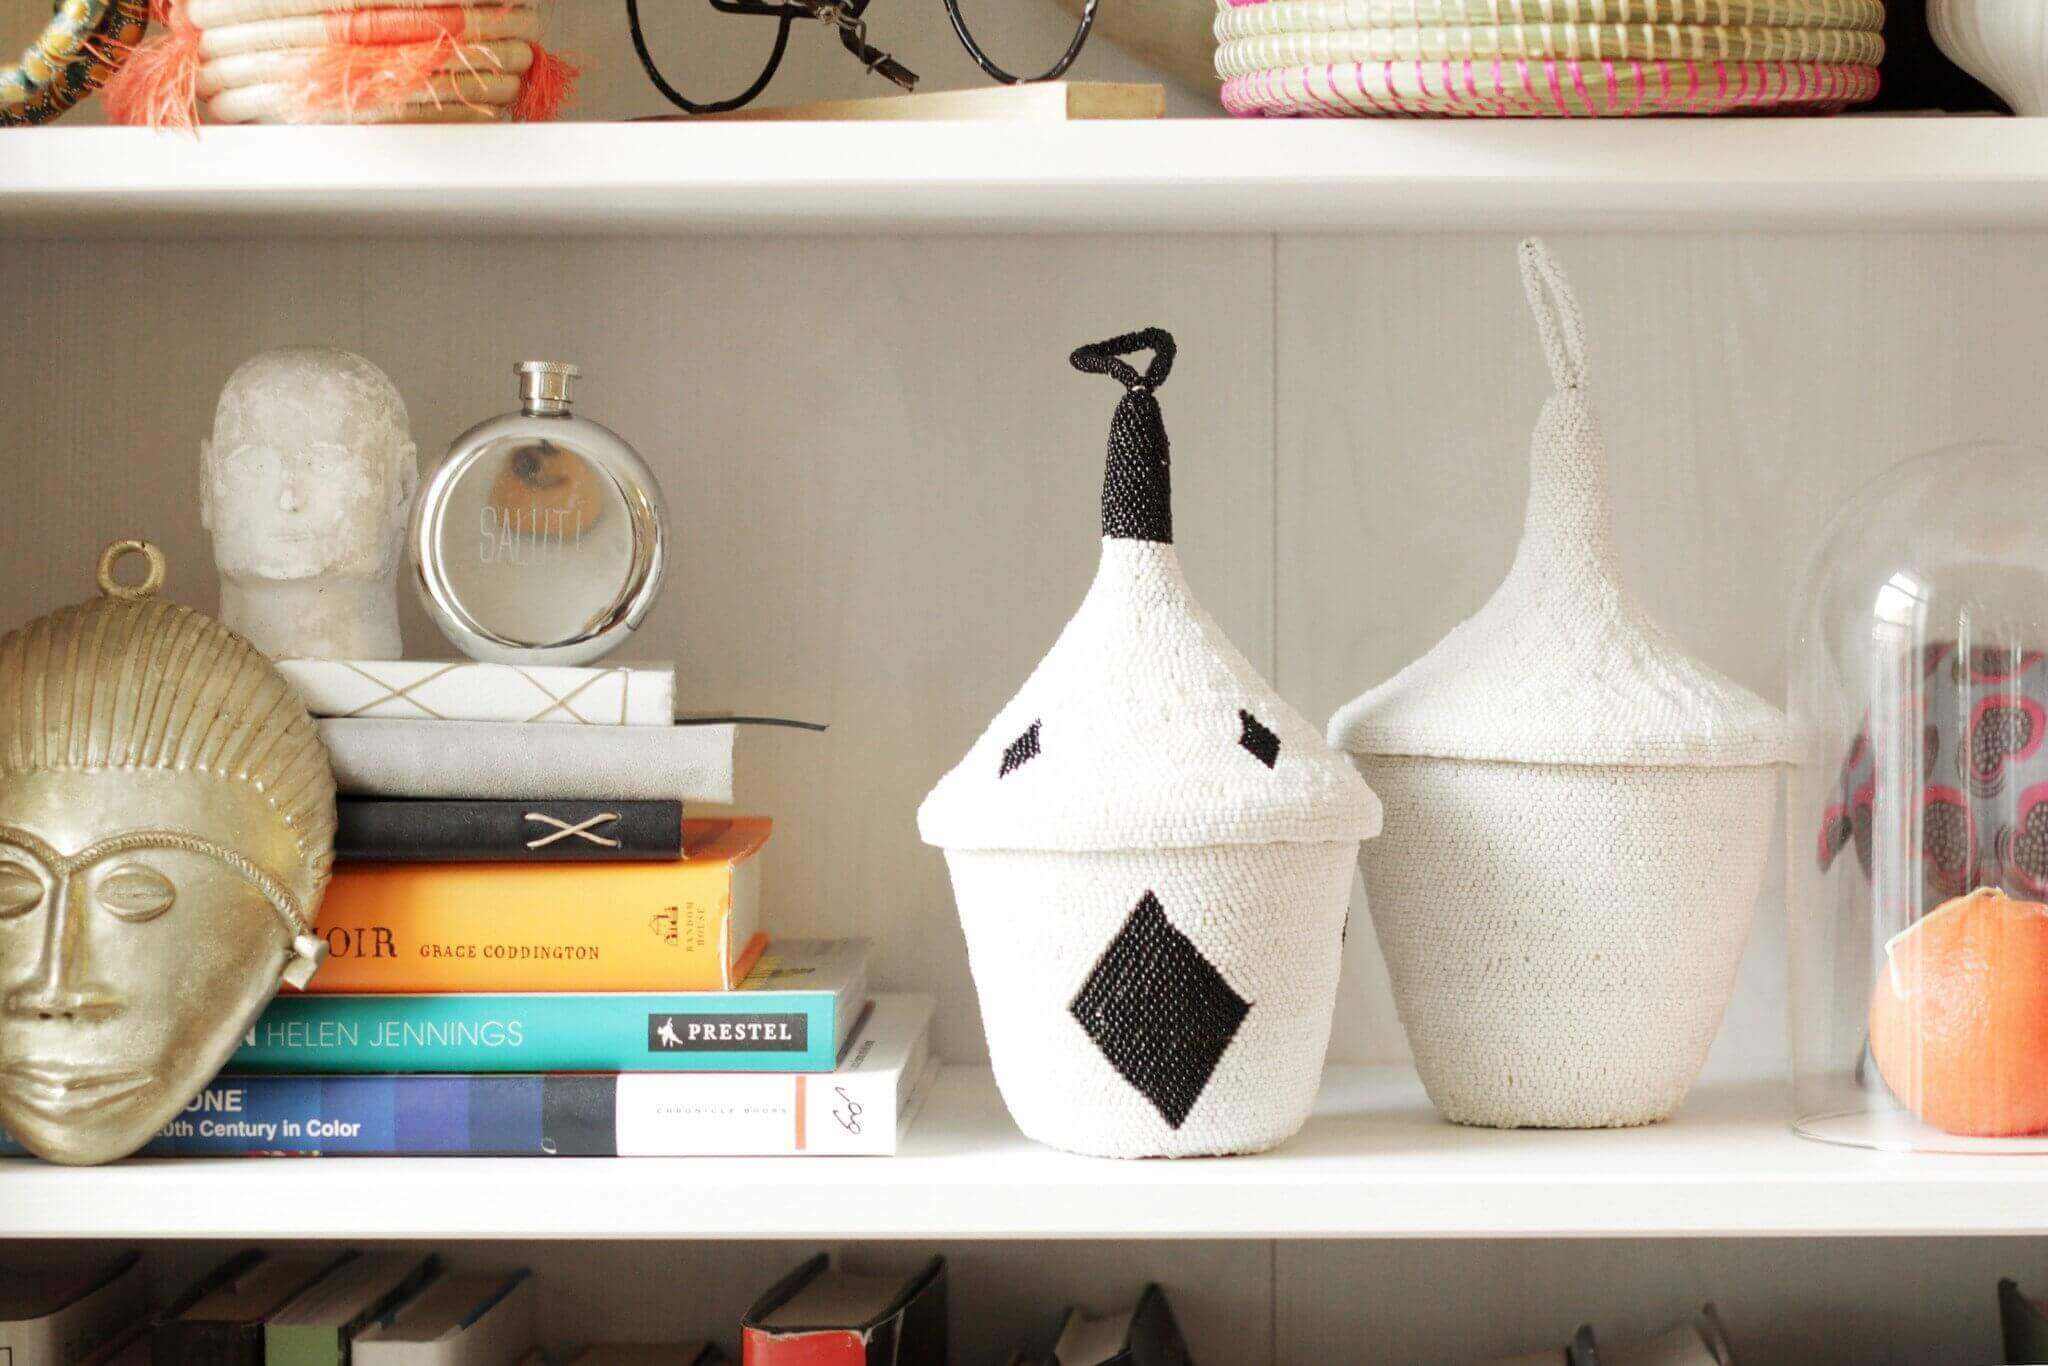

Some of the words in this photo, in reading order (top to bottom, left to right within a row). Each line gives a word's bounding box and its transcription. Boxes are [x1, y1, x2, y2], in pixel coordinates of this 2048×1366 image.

[313, 926, 398, 958] OIR
[419, 943, 477, 959] GRACE
[483, 943, 600, 960] CODDINGTON
[268, 1021, 359, 1047] HELEN
[369, 1020, 524, 1048] JENNINGS
[687, 1023, 793, 1041] PRESTEL
[199, 1119, 277, 1141] Century
[282, 1119, 301, 1137] in
[305, 1119, 361, 1137] Color
